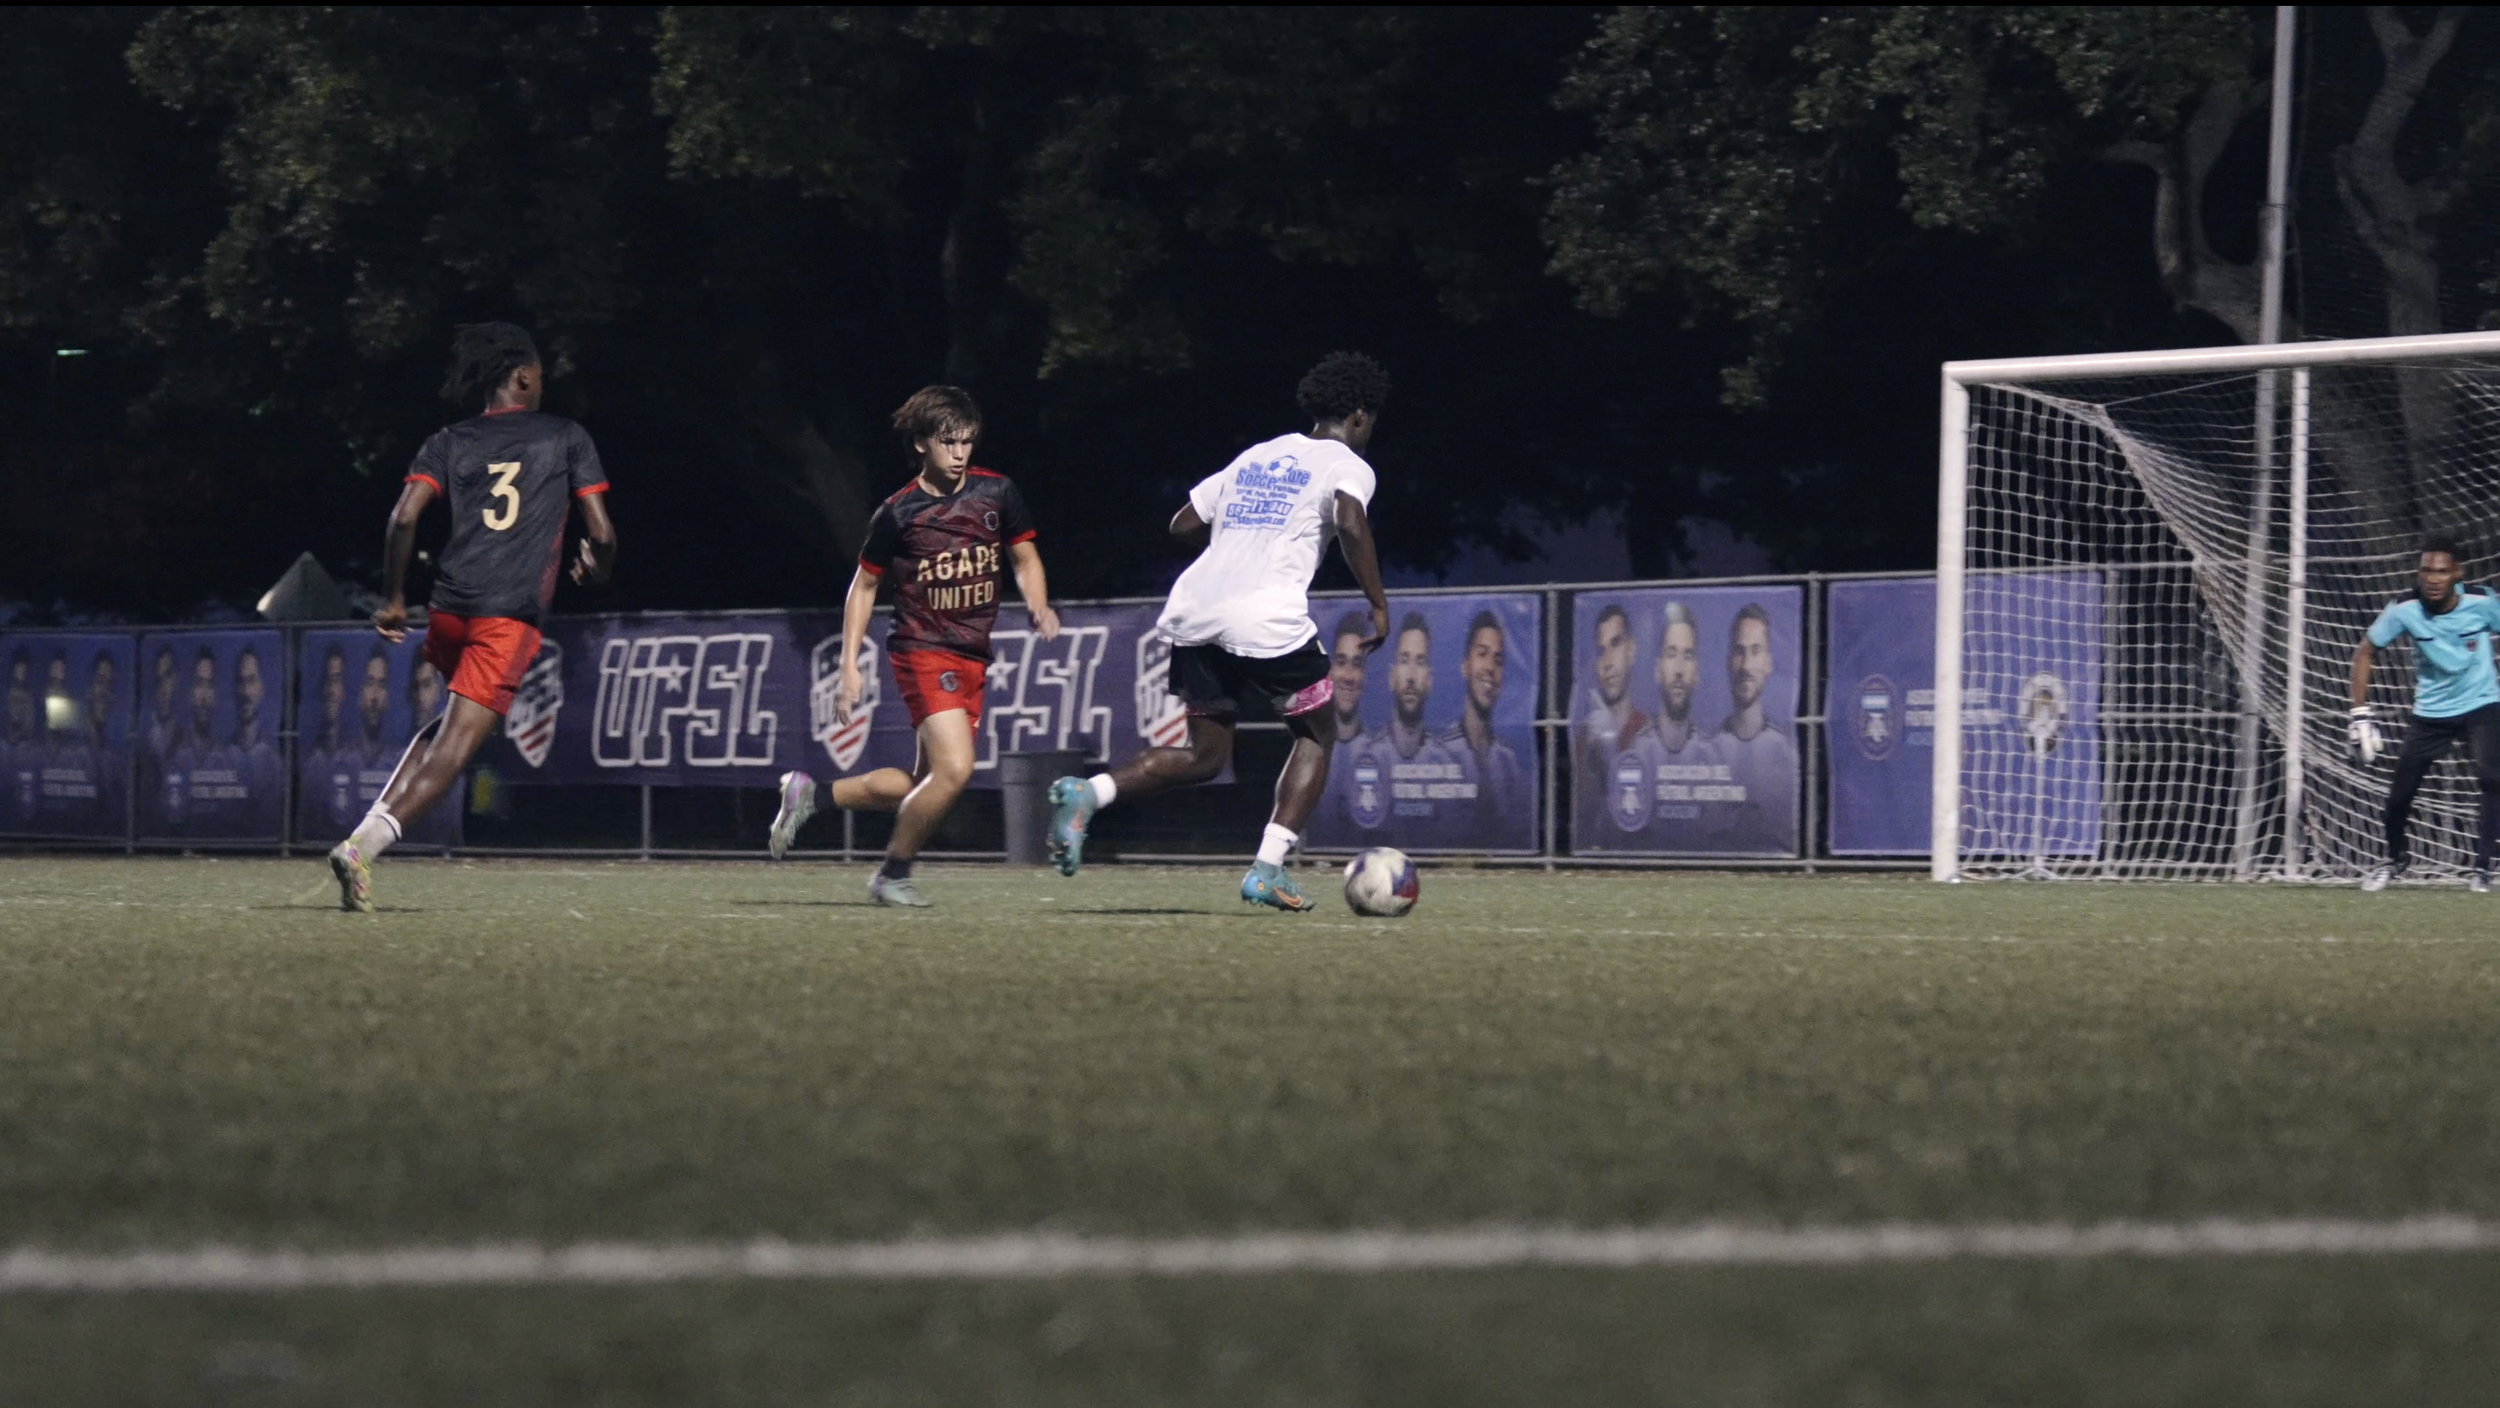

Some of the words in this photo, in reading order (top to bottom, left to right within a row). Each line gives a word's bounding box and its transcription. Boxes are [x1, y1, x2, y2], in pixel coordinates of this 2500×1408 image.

[482, 461, 521, 531] 3
[1236, 467, 1279, 490] Socce
[917, 542, 1000, 582] AGAPE
[928, 580, 994, 611] UNITED
